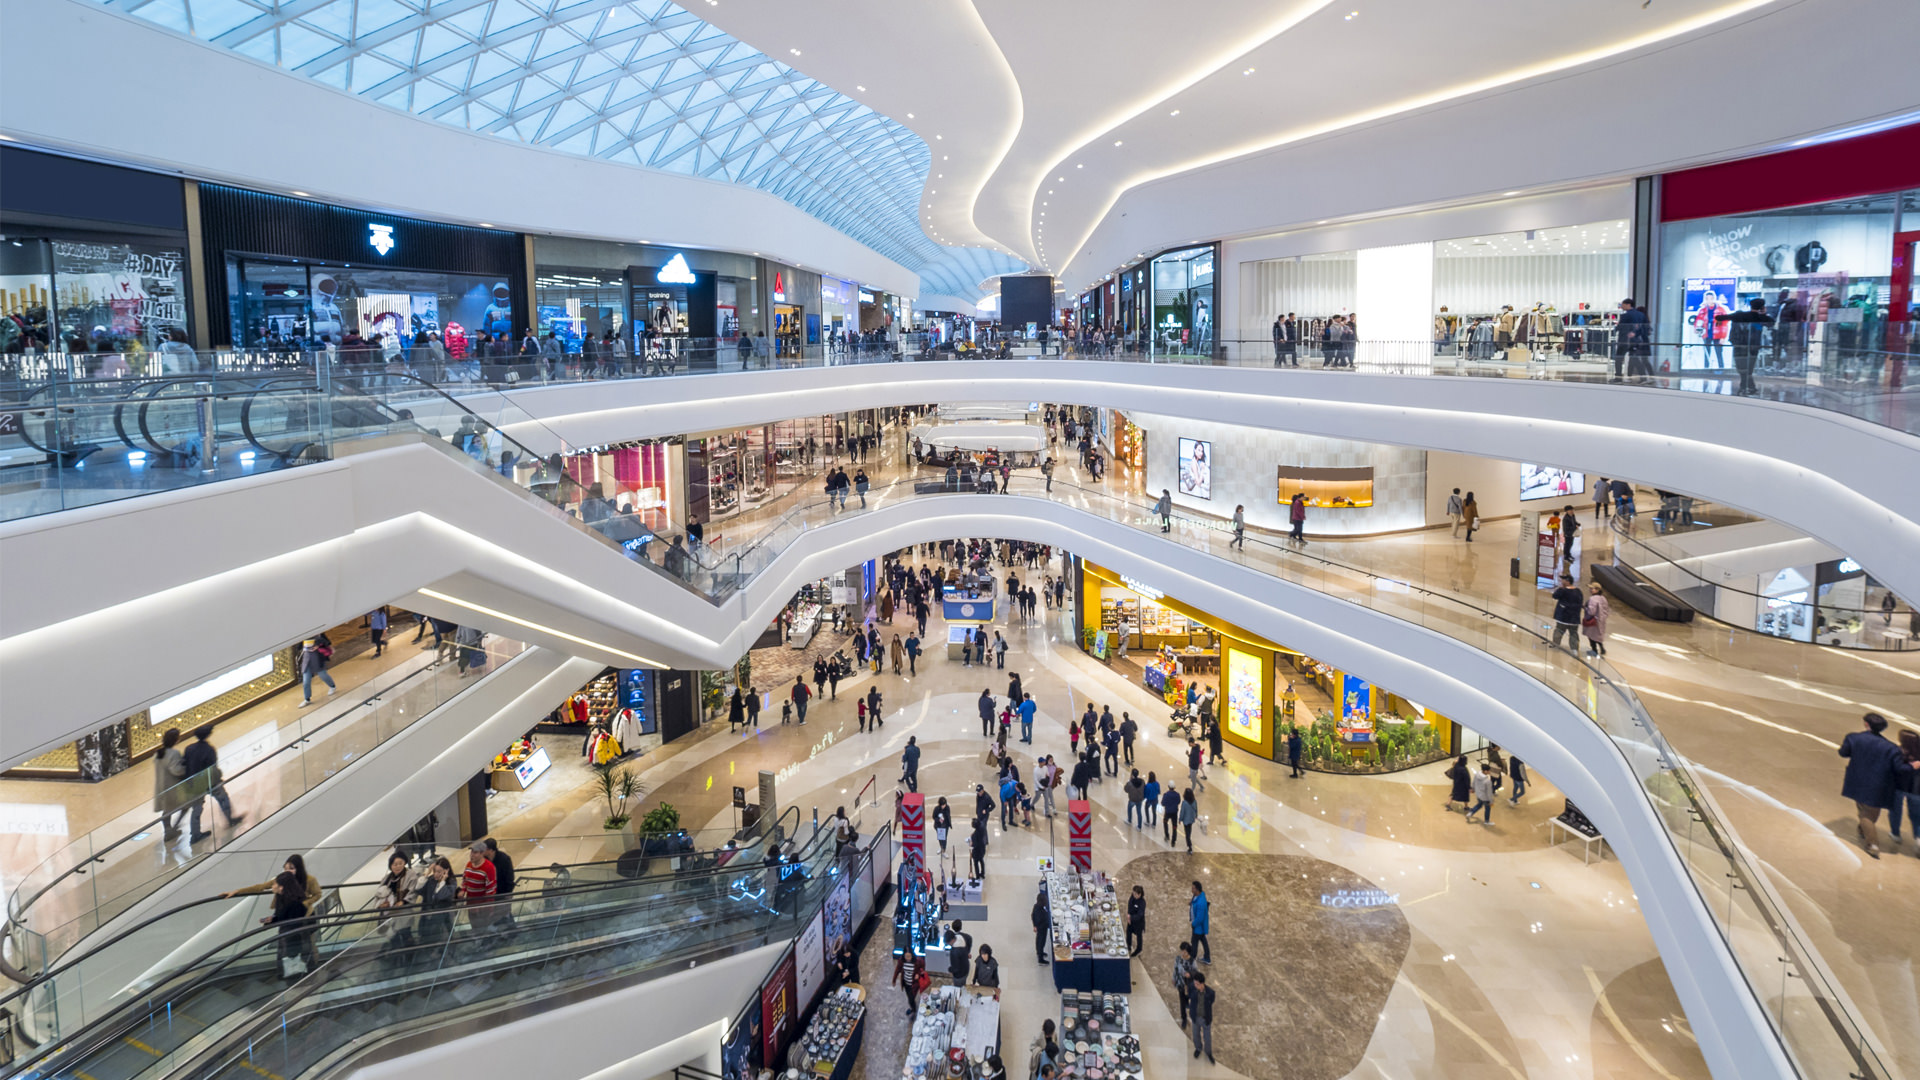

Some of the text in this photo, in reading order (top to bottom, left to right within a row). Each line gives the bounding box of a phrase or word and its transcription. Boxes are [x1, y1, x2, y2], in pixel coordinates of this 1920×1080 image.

[1709, 223, 1753, 248] KNOW
[1739, 243, 1765, 261] NOT
[138, 300, 185, 321] NIGHT
